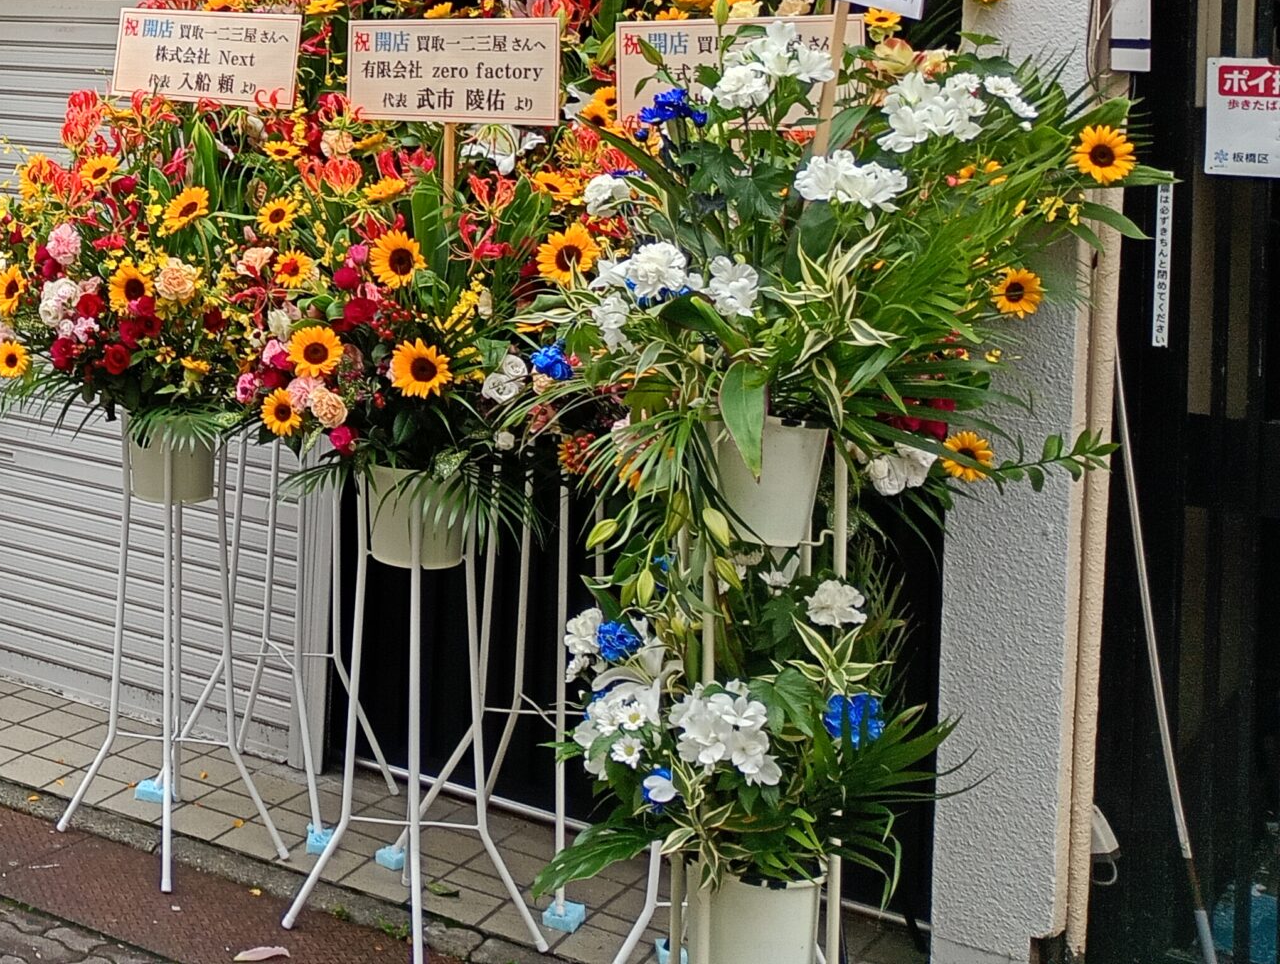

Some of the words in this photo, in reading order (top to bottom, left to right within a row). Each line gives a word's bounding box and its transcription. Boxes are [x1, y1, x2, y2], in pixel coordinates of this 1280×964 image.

[142, 19, 175, 39] 開店
[374, 31, 410, 52] 開店
[155, 45, 210, 64] 株式会社
[218, 50, 256, 67] Next
[361, 60, 423, 79] 有限会社
[432, 66, 468, 79] zero
[476, 62, 544, 81] factory
[239, 81, 257, 95] より
[383, 92, 408, 108] 代表
[417, 87, 455, 110] 武市
[514, 97, 533, 111] より
[1227, 99, 1280, 111] 歩きたば
[1232, 151, 1270, 164] 板橋区
